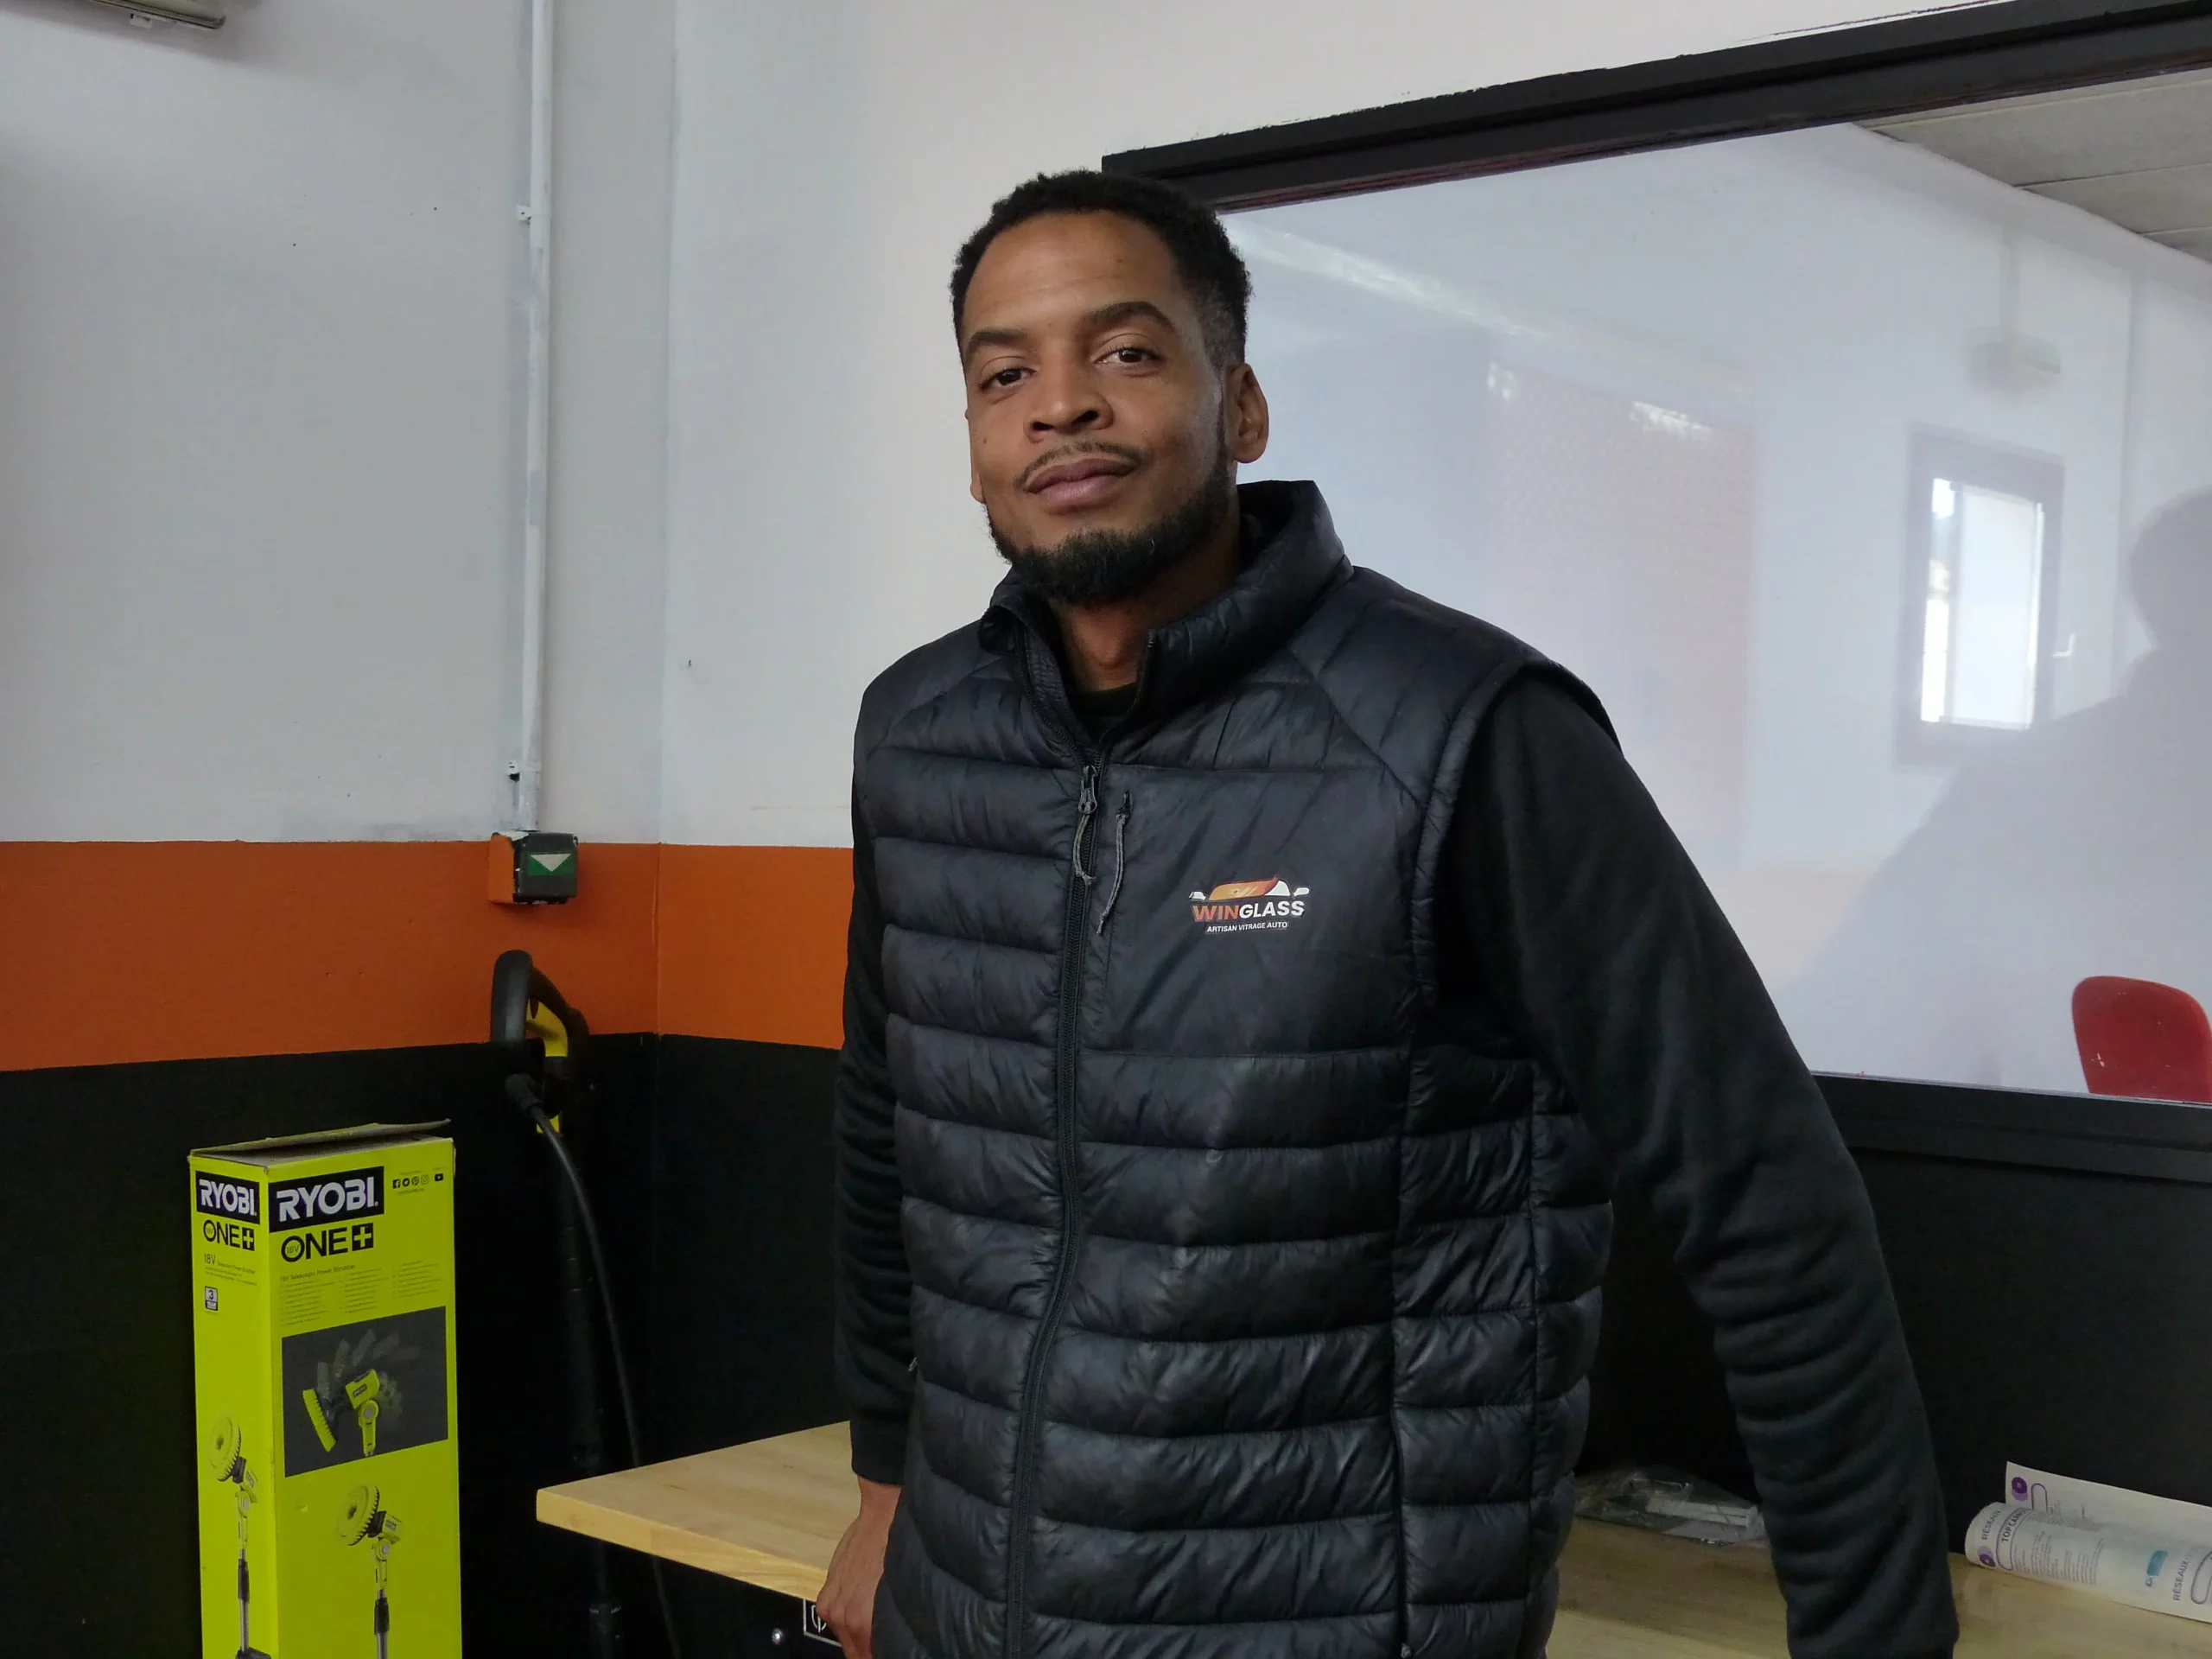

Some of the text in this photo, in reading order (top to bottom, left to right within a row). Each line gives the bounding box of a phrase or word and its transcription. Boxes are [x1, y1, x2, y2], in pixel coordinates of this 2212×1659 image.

[1192, 900, 1305, 921] WINGLASS
[1206, 925, 1237, 933] ARTISAN
[1238, 922, 1266, 931] VITRAGE
[199, 1179, 256, 1216] RYOBI
[276, 1176, 378, 1222] RYOBI
[204, 1253, 216, 1265] 18V
